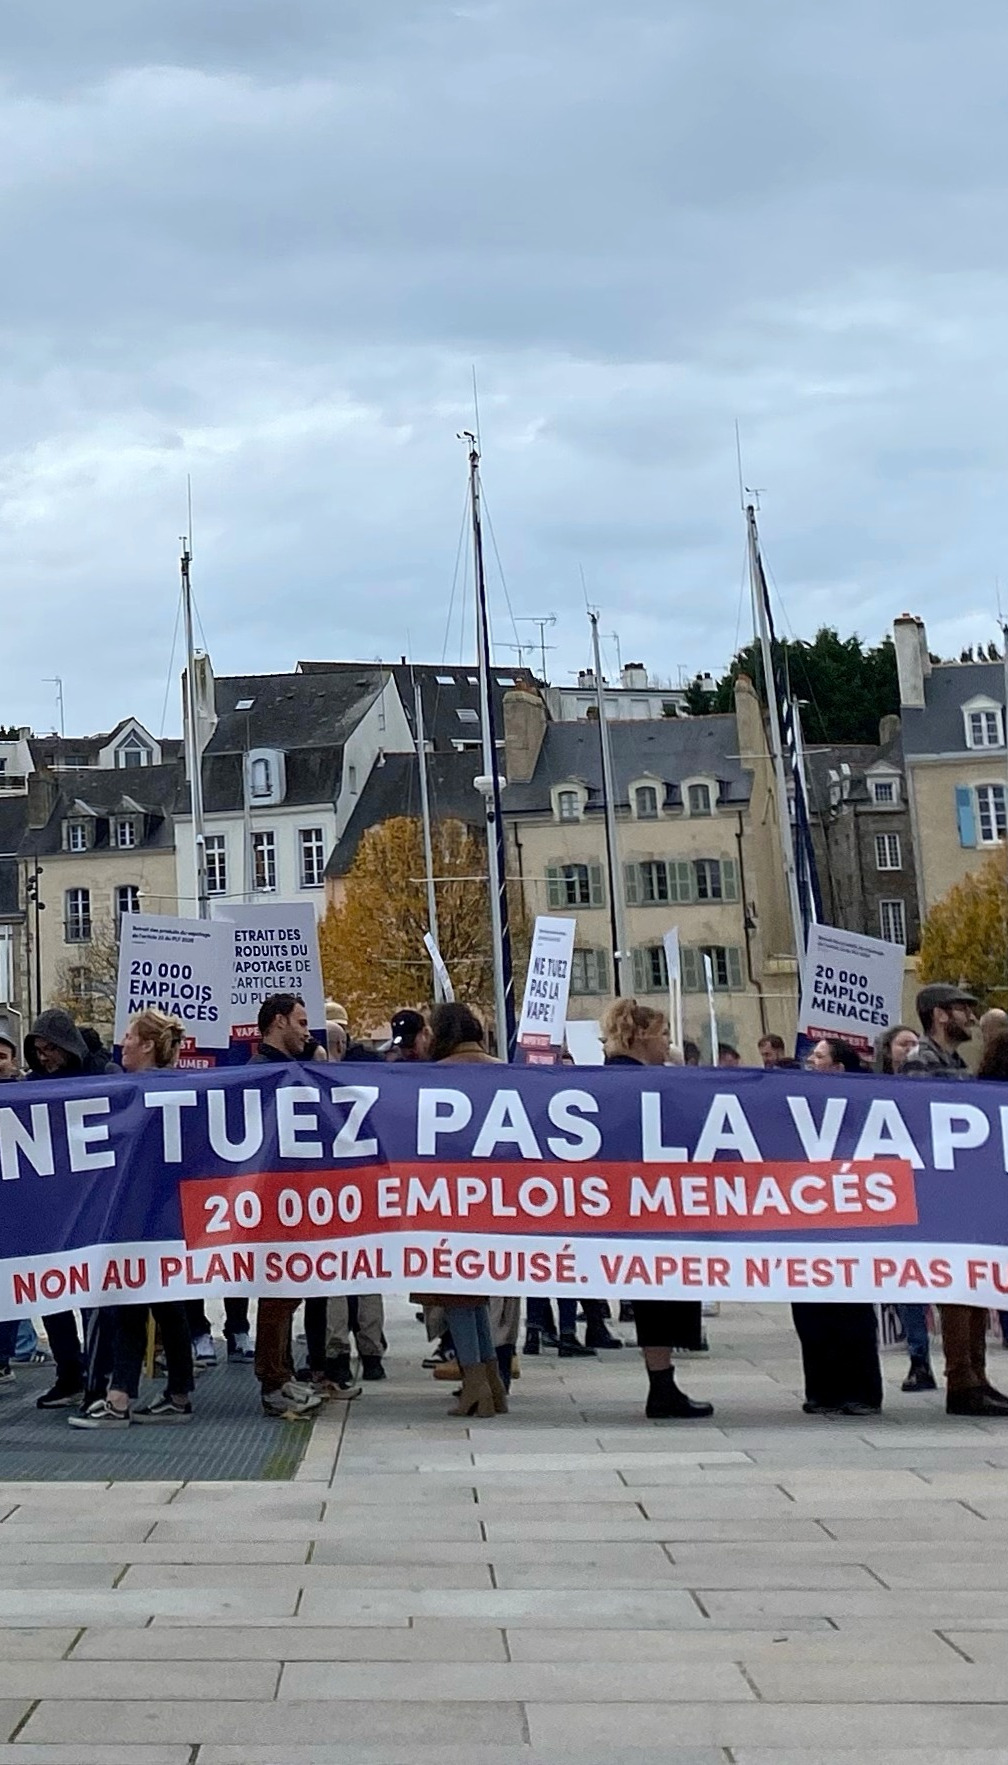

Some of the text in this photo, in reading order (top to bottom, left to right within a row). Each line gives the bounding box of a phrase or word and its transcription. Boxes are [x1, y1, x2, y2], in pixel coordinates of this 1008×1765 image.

[235, 929, 301, 942] ETRAIT DES
[235, 944, 308, 958] RODUITS DU
[131, 960, 192, 979] 20 000
[233, 960, 311, 973] APOTAGE DE
[533, 956, 568, 979] NE TUEZ
[815, 965, 868, 988] 20 000
[129, 979, 212, 1001] EMPLOIS
[232, 976, 302, 989] 'ARTICLE 23
[529, 979, 560, 1000] PAS LA
[231, 993, 247, 1005] DU
[813, 980, 884, 1008] EMPLOIS
[811, 997, 889, 1026] MENACÉS
[234, 1026, 261, 1037] VAPE
[0, 1097, 116, 1180] NE
[144, 1086, 379, 1164] TUEZ
[417, 1088, 602, 1162] PAS
[641, 1092, 762, 1163] LA
[204, 1163, 898, 1234] 20 000 EMPLOIS MENACÉS
[13, 1262, 91, 1305] NON
[102, 1258, 147, 1292] AU
[161, 1250, 255, 1288] PLAN
[265, 1247, 392, 1283] SOCIAL
[403, 1238, 589, 1285] DÉGUISÉ.
[600, 1254, 731, 1287] VAPER
[745, 1257, 860, 1289] N'EST
[873, 1258, 954, 1289] PAS
